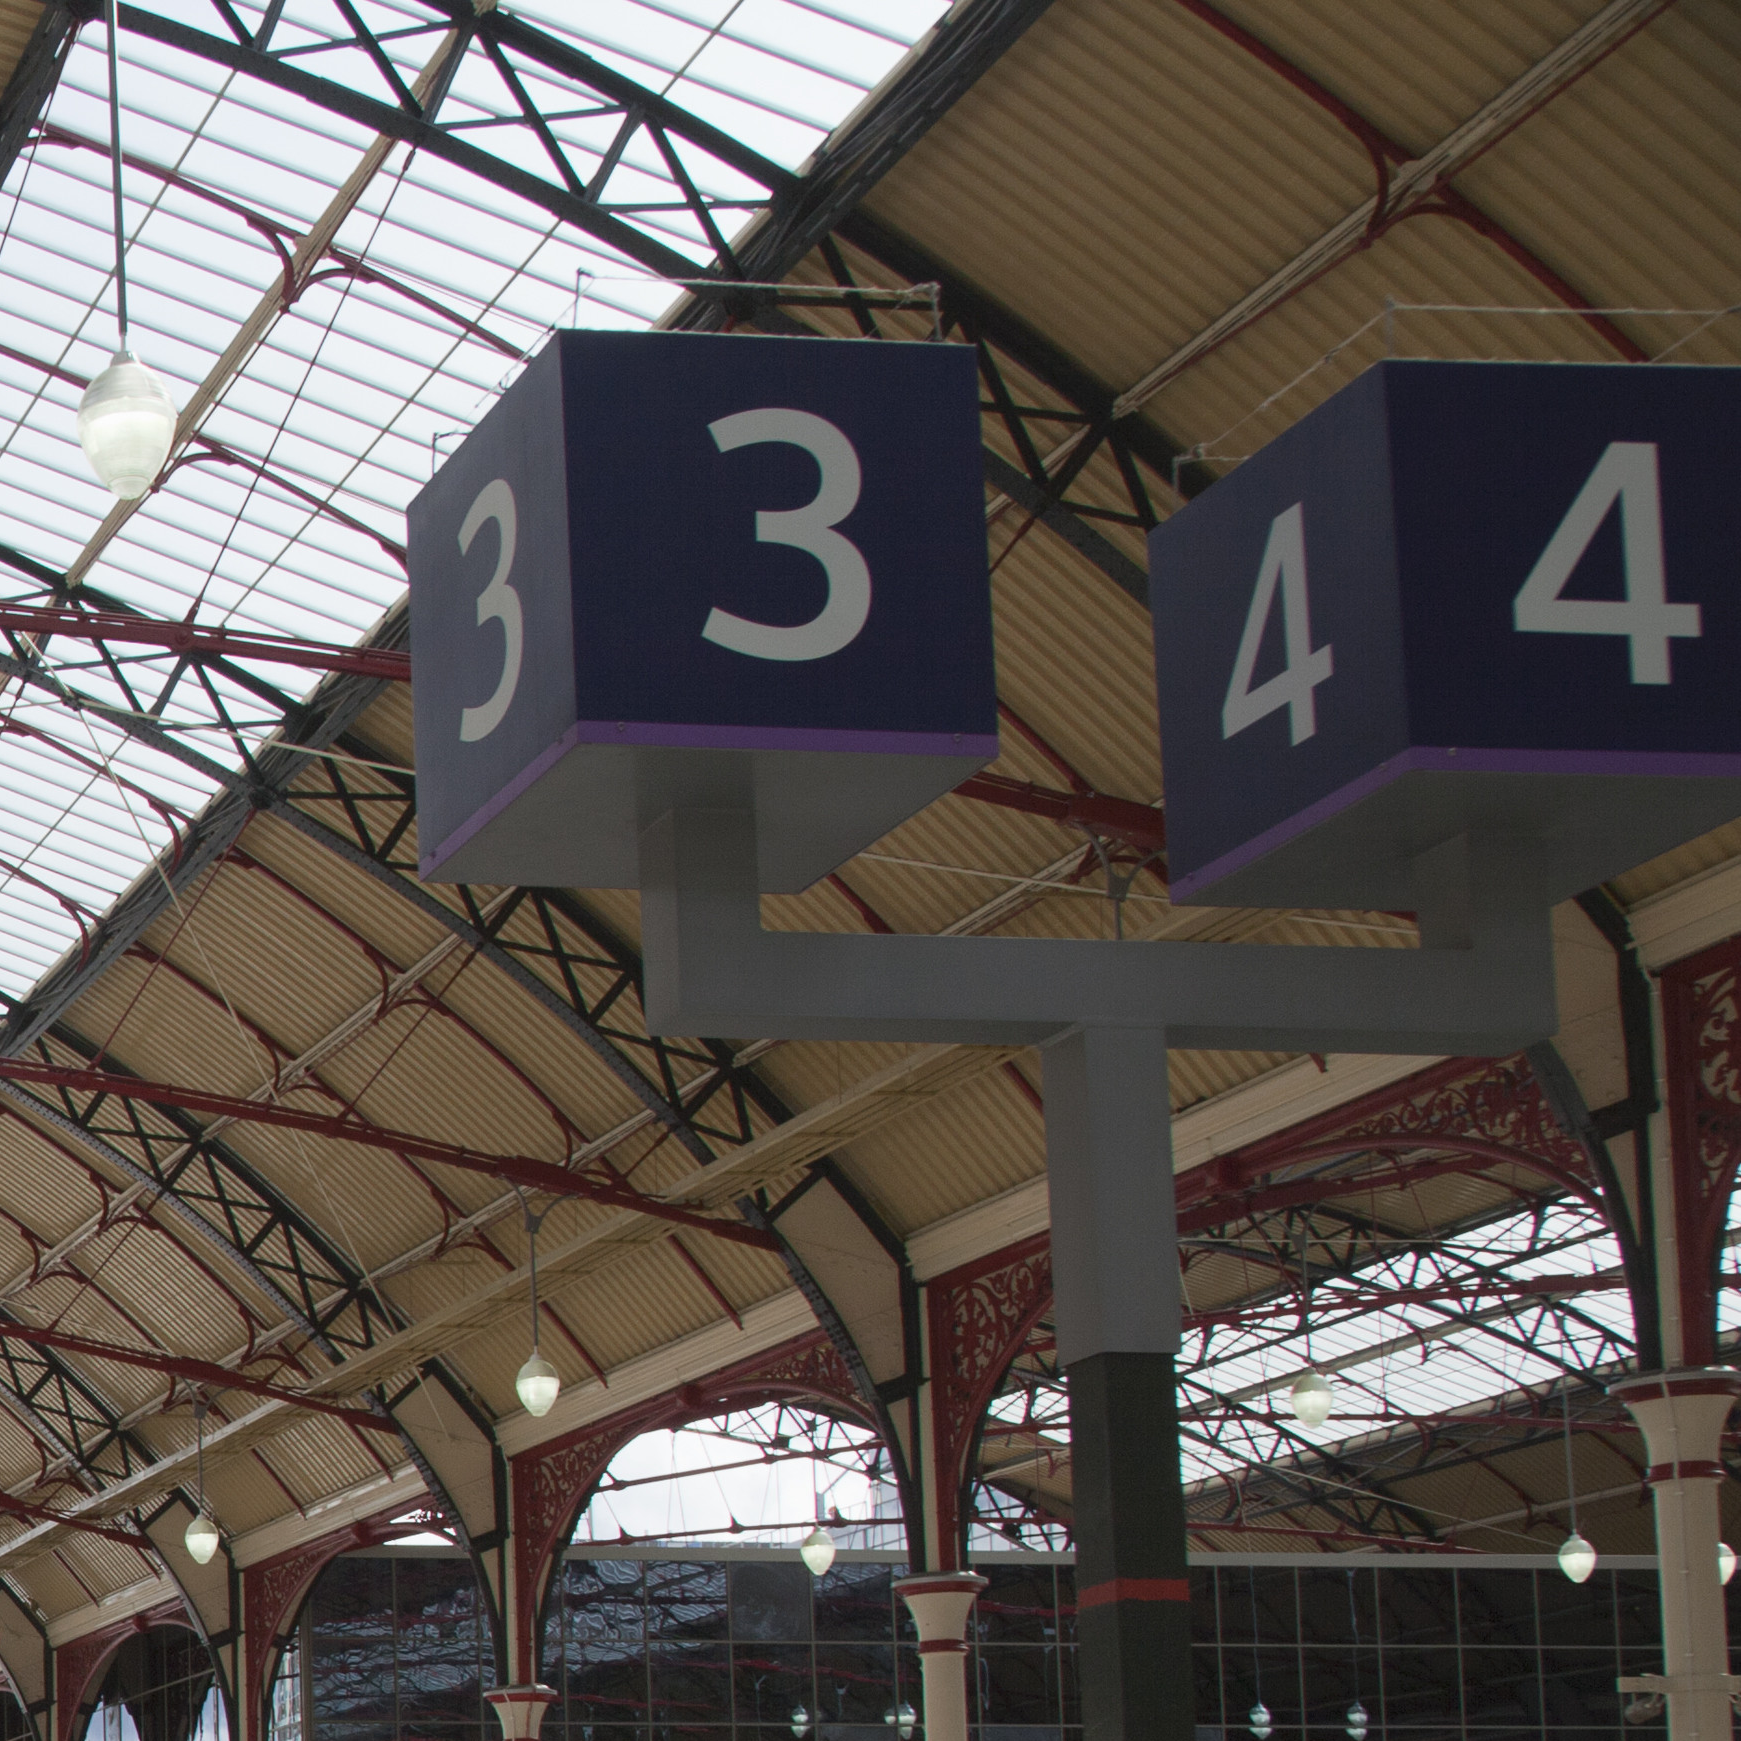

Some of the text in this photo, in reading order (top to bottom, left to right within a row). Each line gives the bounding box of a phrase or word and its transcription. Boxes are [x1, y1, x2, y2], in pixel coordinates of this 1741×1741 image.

[457, 477, 525, 744] 3
[700, 406, 872, 662] 3
[1220, 502, 1334, 747] 4
[1511, 441, 1702, 685] 4
